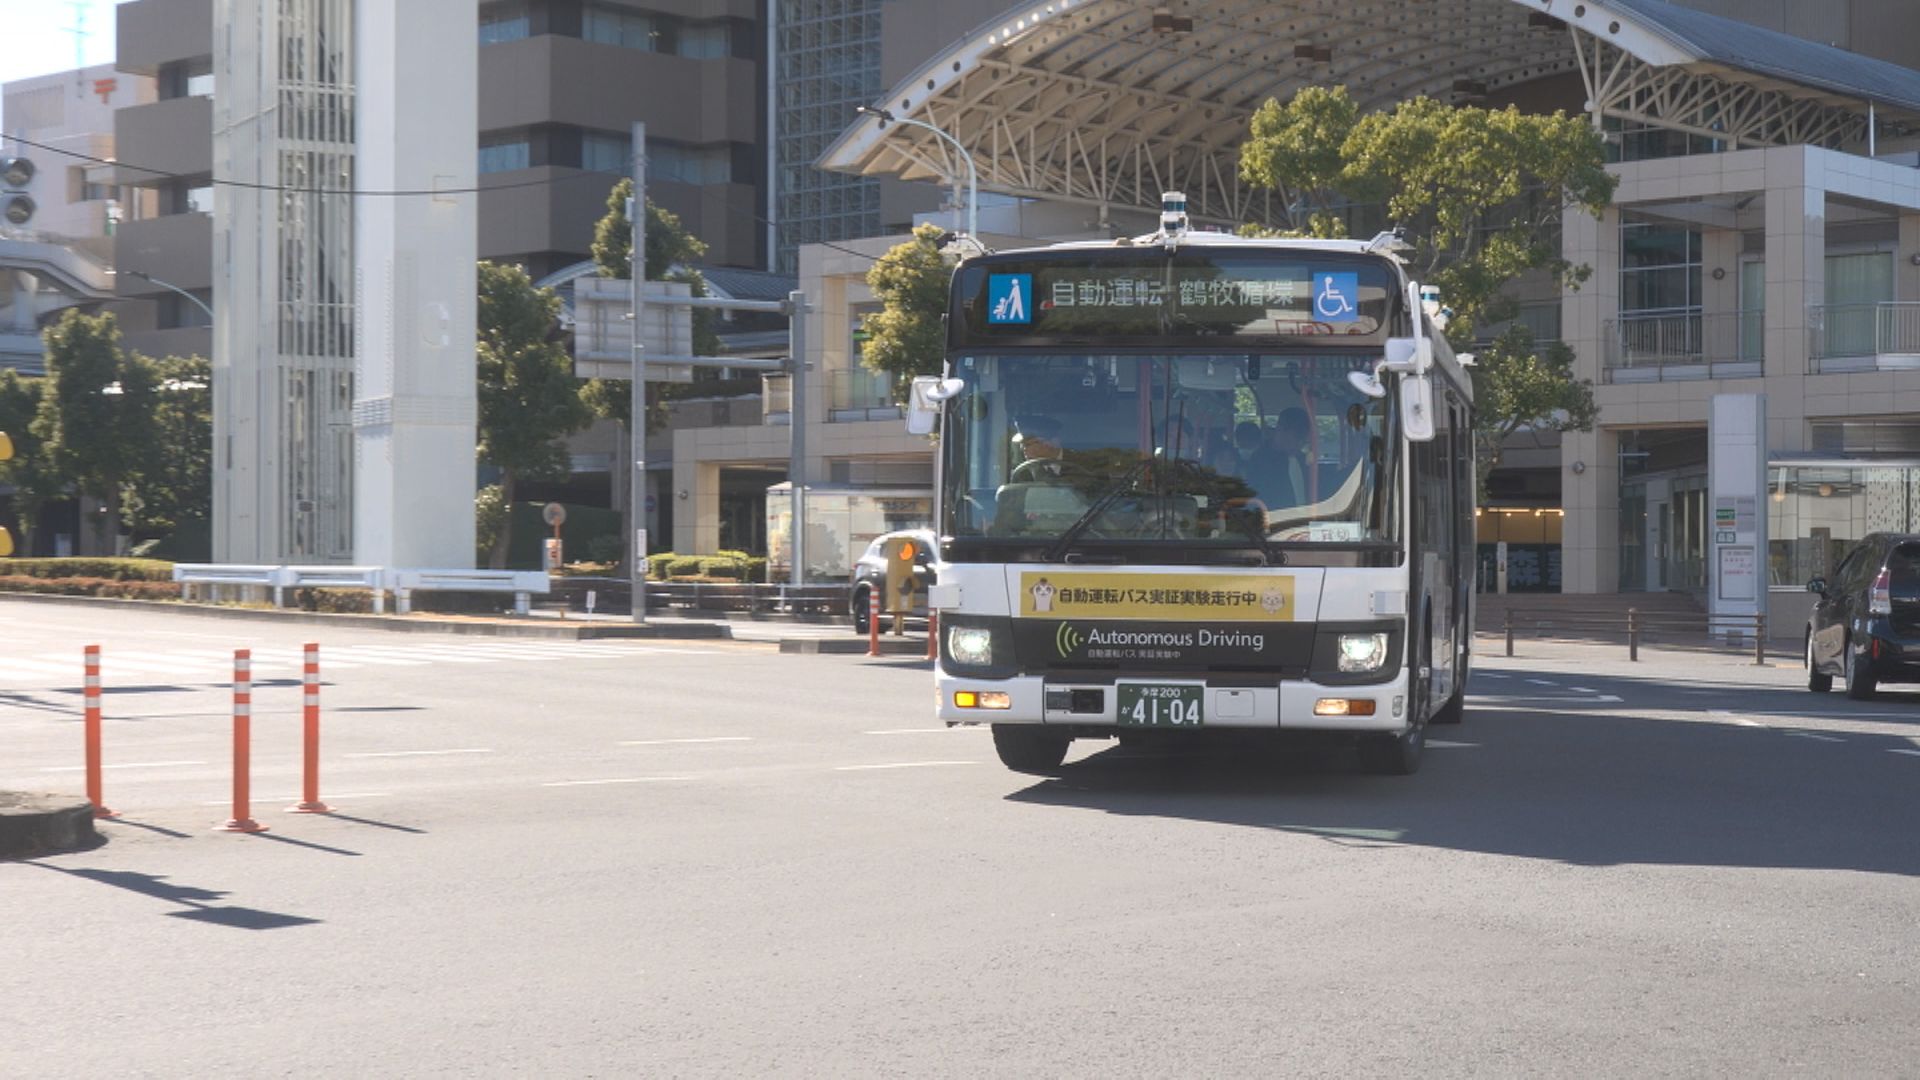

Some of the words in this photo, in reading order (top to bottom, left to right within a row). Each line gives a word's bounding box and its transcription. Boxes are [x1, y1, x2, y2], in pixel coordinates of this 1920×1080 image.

[1052, 279, 1163, 307] 自動運転
[1179, 279, 1294, 307] 鶴牧循環
[1059, 588, 1257, 607] 自動運転バス実証実験走行中
[1087, 628, 1193, 646] Autonomous
[1198, 629, 1264, 652] Driving
